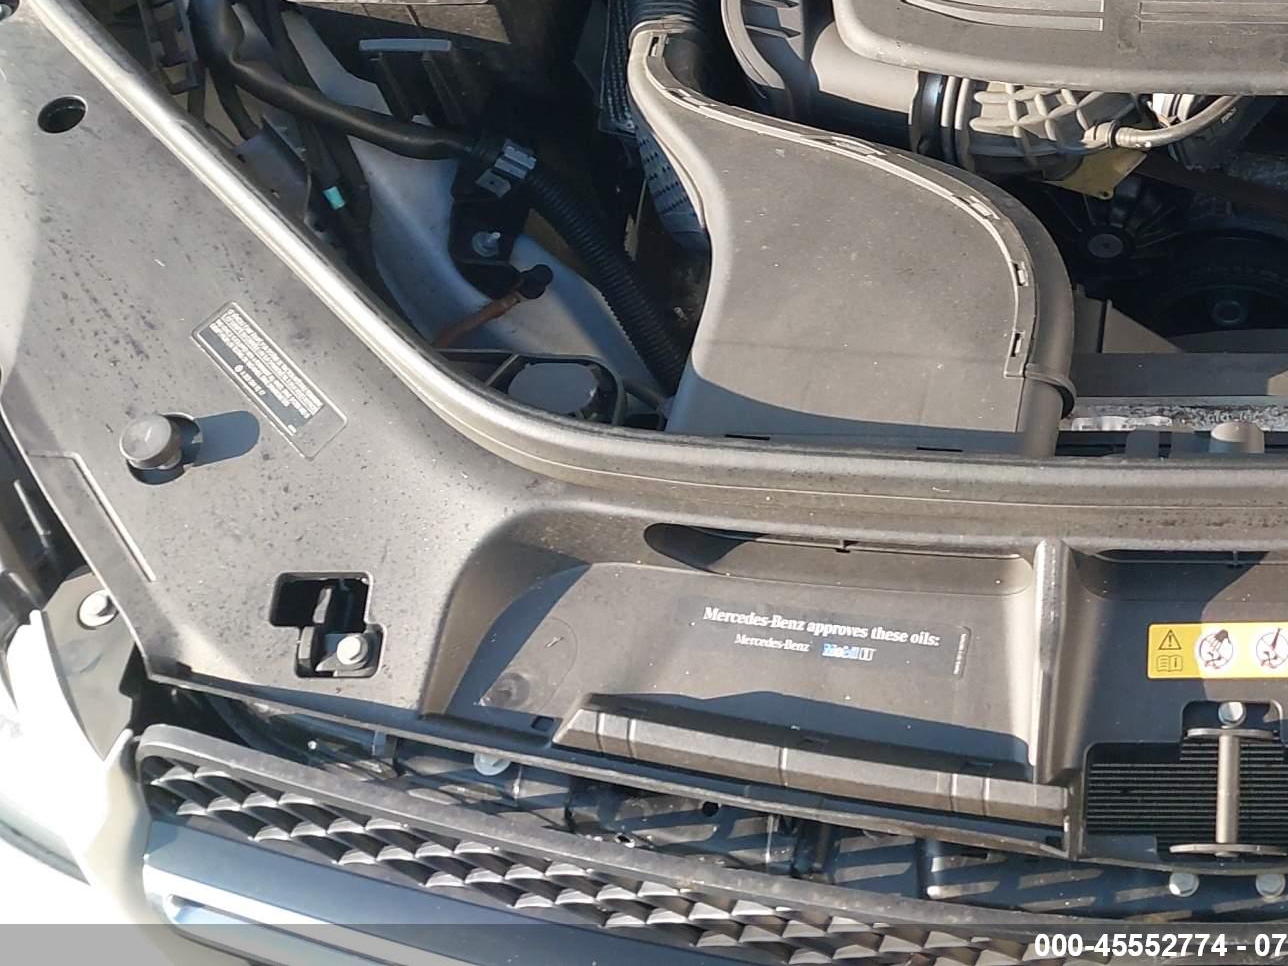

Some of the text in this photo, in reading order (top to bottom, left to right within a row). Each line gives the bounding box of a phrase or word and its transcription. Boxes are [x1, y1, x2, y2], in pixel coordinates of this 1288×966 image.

[703, 606, 940, 647] Mercedes-Benz approves these oils:
[734, 633, 811, 652] Mercedes-Benz
